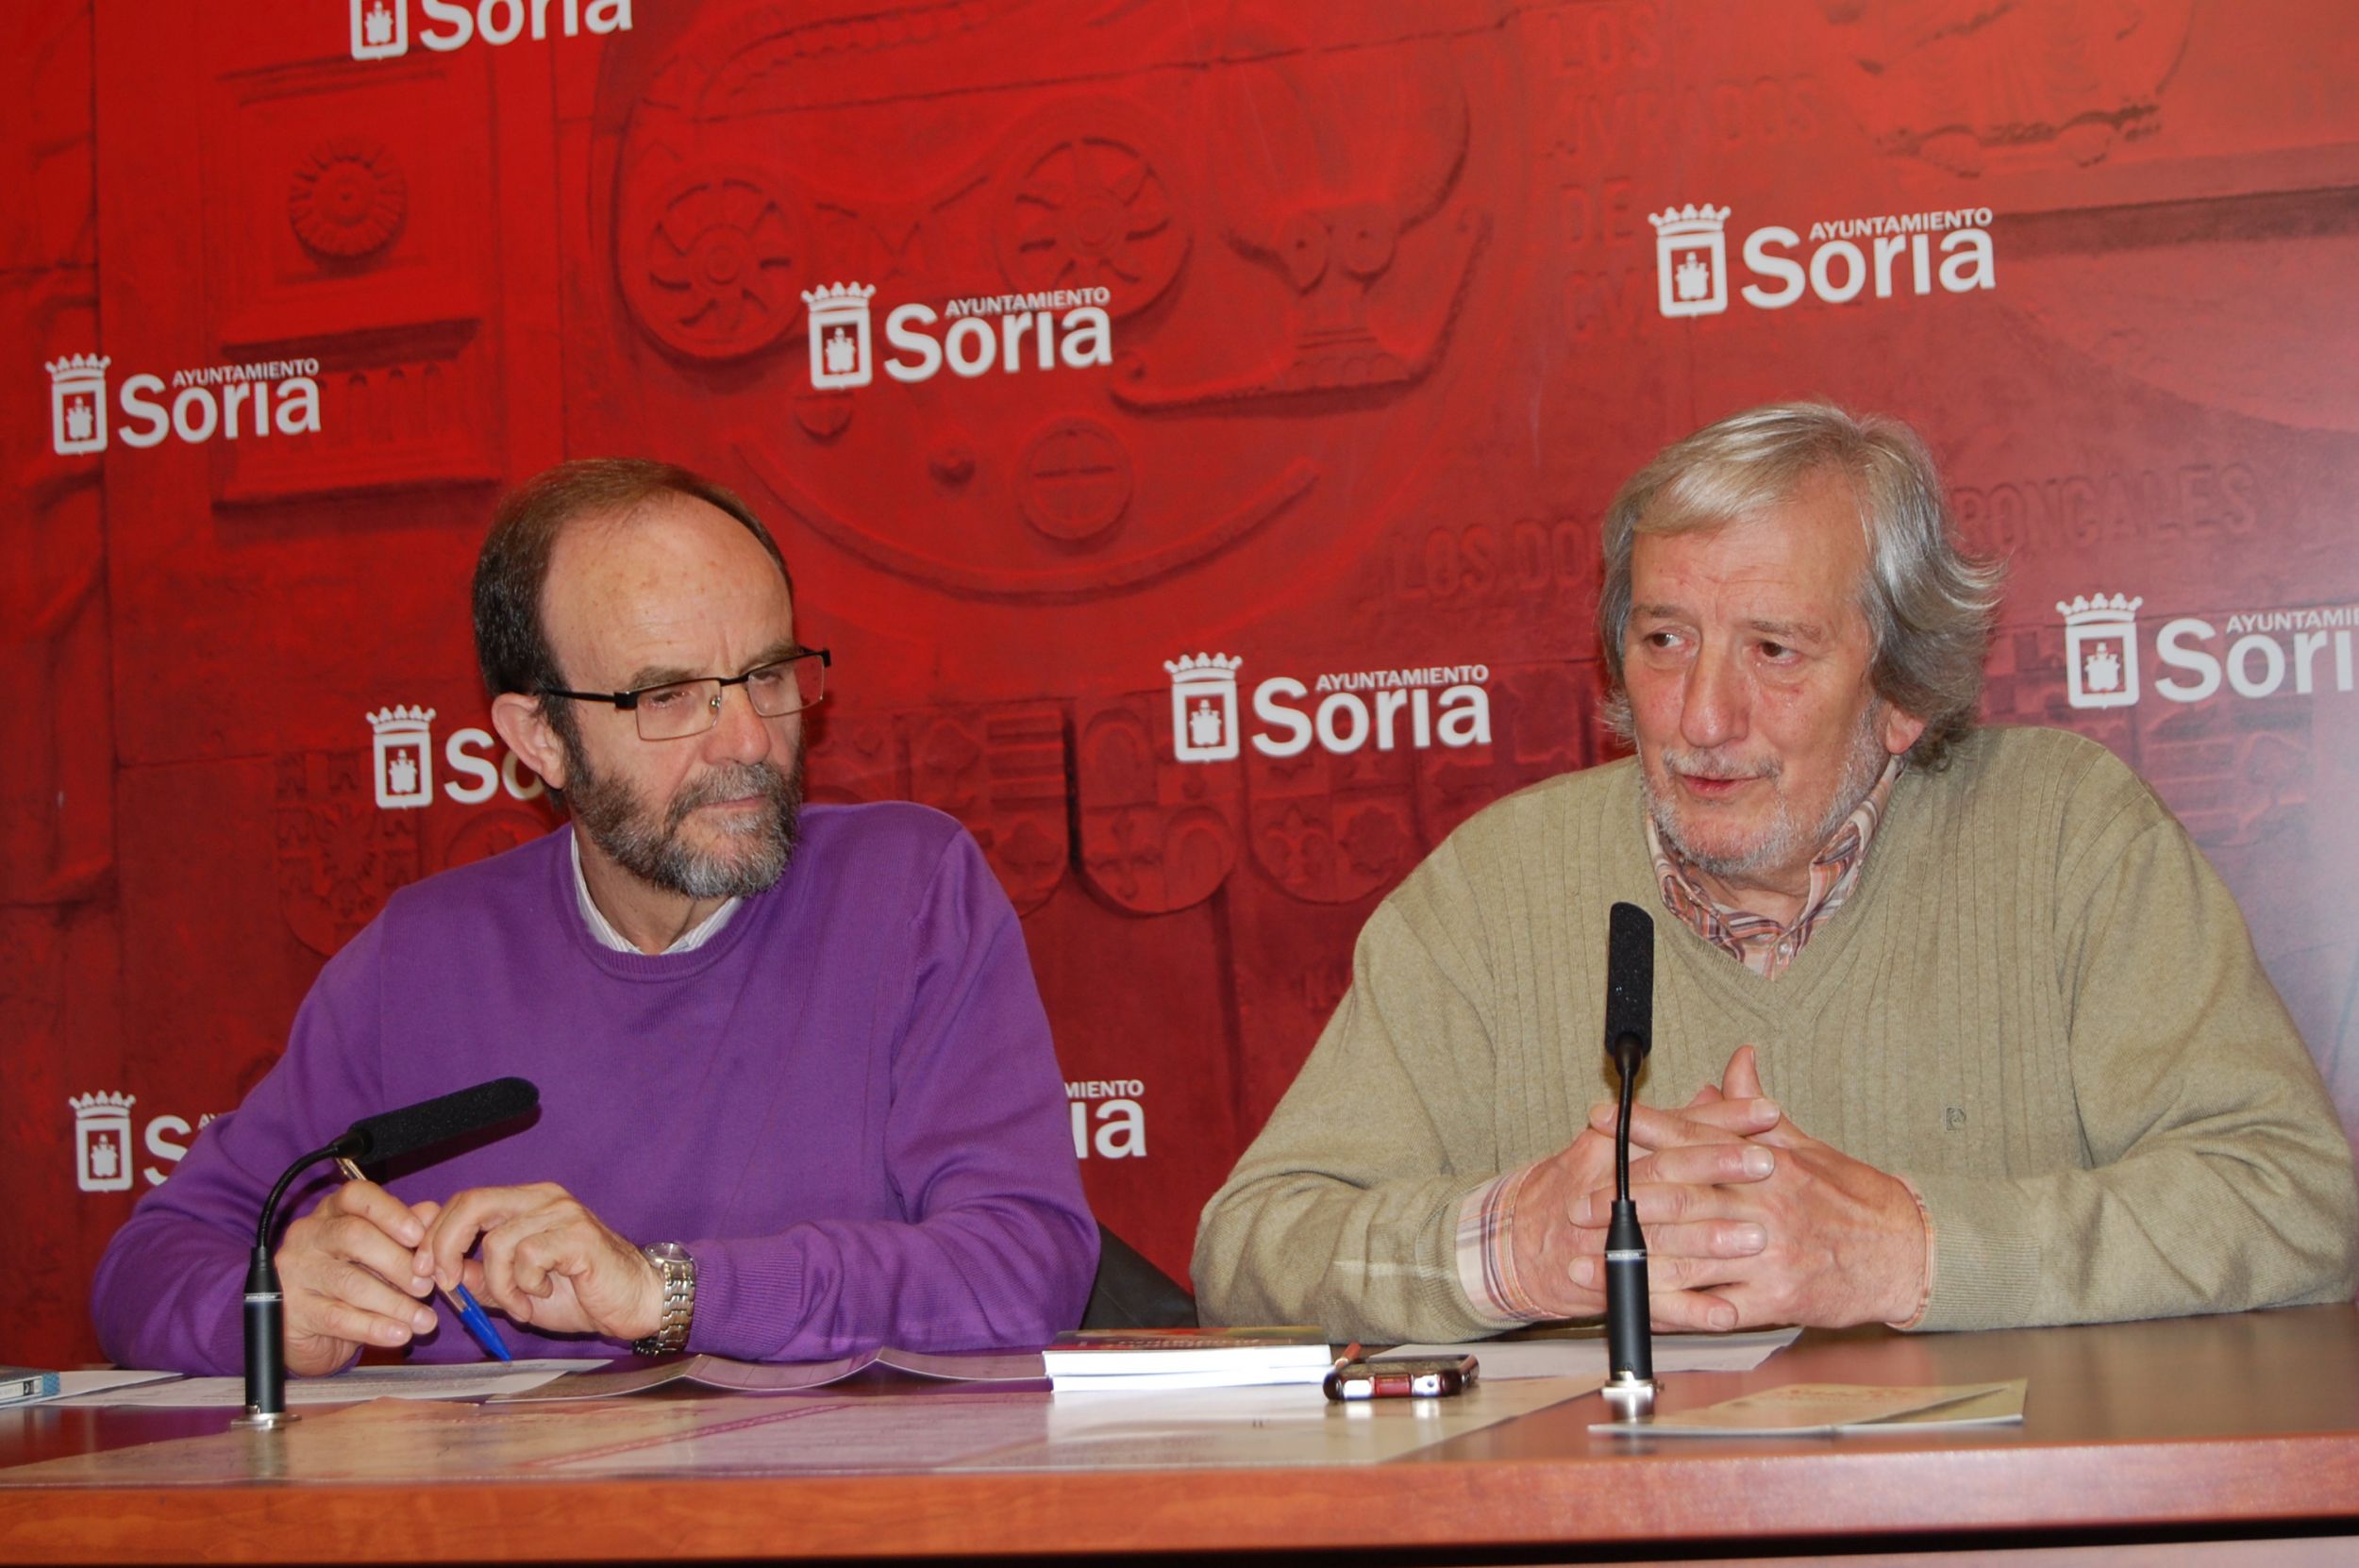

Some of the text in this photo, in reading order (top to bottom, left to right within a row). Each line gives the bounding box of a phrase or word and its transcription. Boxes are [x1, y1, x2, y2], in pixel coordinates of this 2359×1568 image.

[1808, 207, 1994, 242] AYUNTAMIENTO
[1741, 225, 1997, 309] Soria
[945, 287, 1112, 317] AYUNTAMIENTO
[883, 304, 1113, 382] Soria
[173, 358, 321, 388] AYUNTAMIENTO
[119, 375, 322, 447] Soria
[1315, 664, 1490, 693] AYUNTAMIENTO
[1251, 676, 1494, 758] Soria
